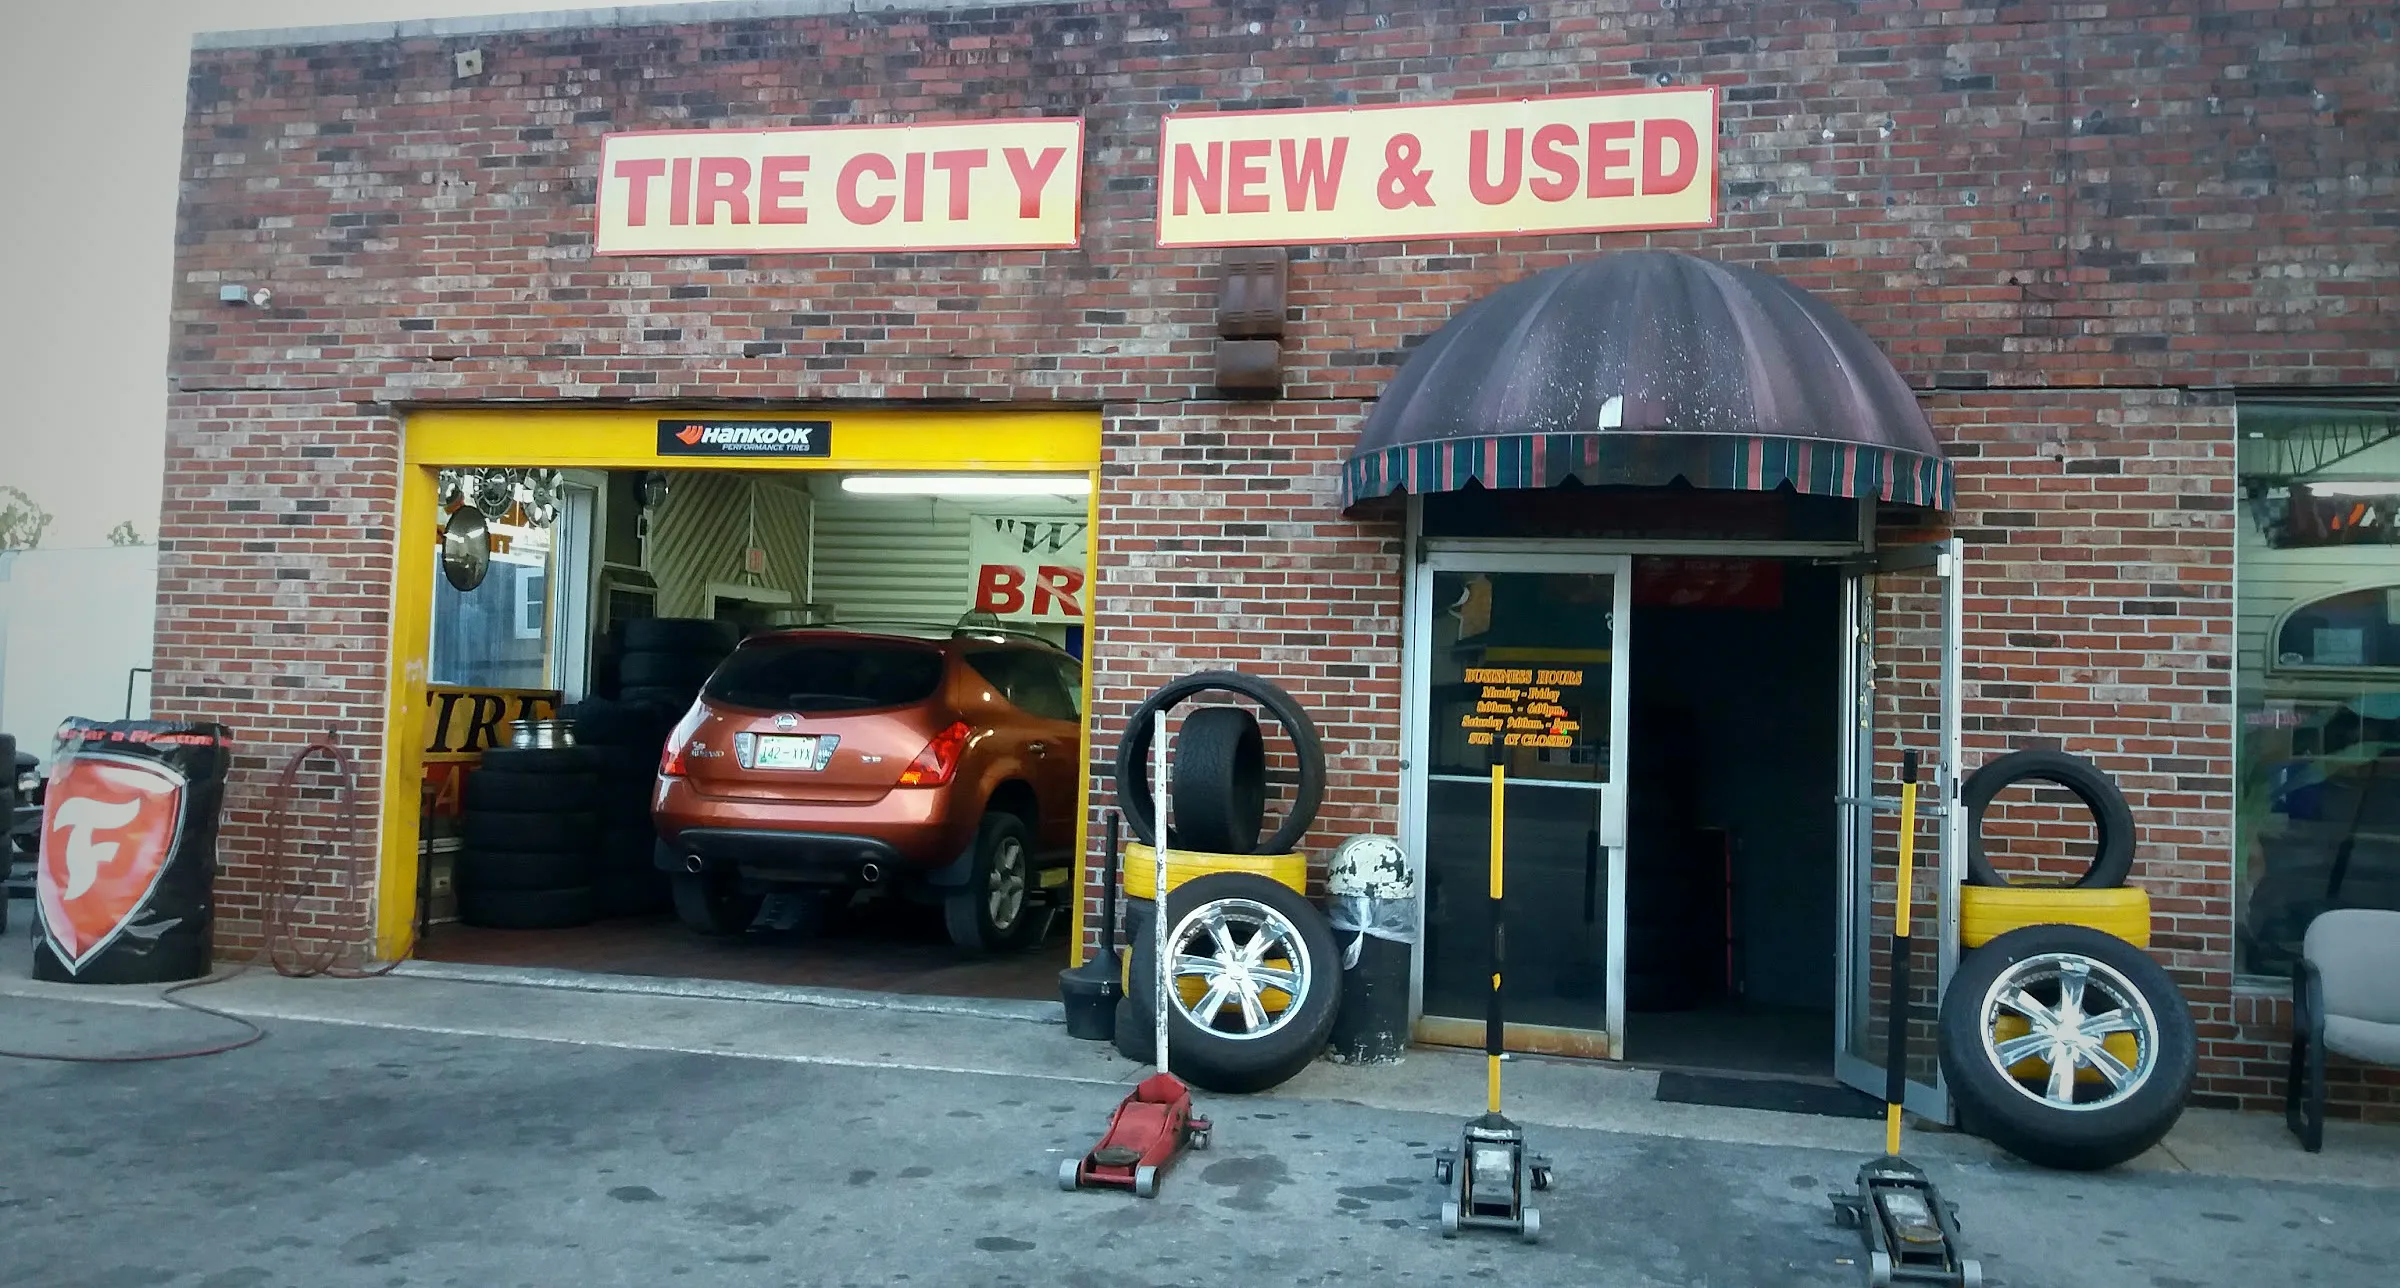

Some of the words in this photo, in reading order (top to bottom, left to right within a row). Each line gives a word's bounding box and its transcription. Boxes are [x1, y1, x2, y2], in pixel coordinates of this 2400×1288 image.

[1172, 136, 1349, 216] NEW
[1376, 132, 1436, 210] &
[1468, 118, 1699, 205] USED
[614, 155, 811, 227] TIRE
[836, 147, 1067, 226] CITY
[722, 444, 784, 452] PERFORMANCE
[1464, 668, 1532, 684] BUSINESS
[1536, 670, 1583, 685] HOURS
[1481, 686, 1520, 702] Monday
[1528, 687, 1560, 702] Friday
[1461, 715, 1503, 730] Saturday
[1468, 732, 1521, 746] SUNAY
[1521, 733, 1573, 747] CLOSED
[53, 797, 141, 900] F
